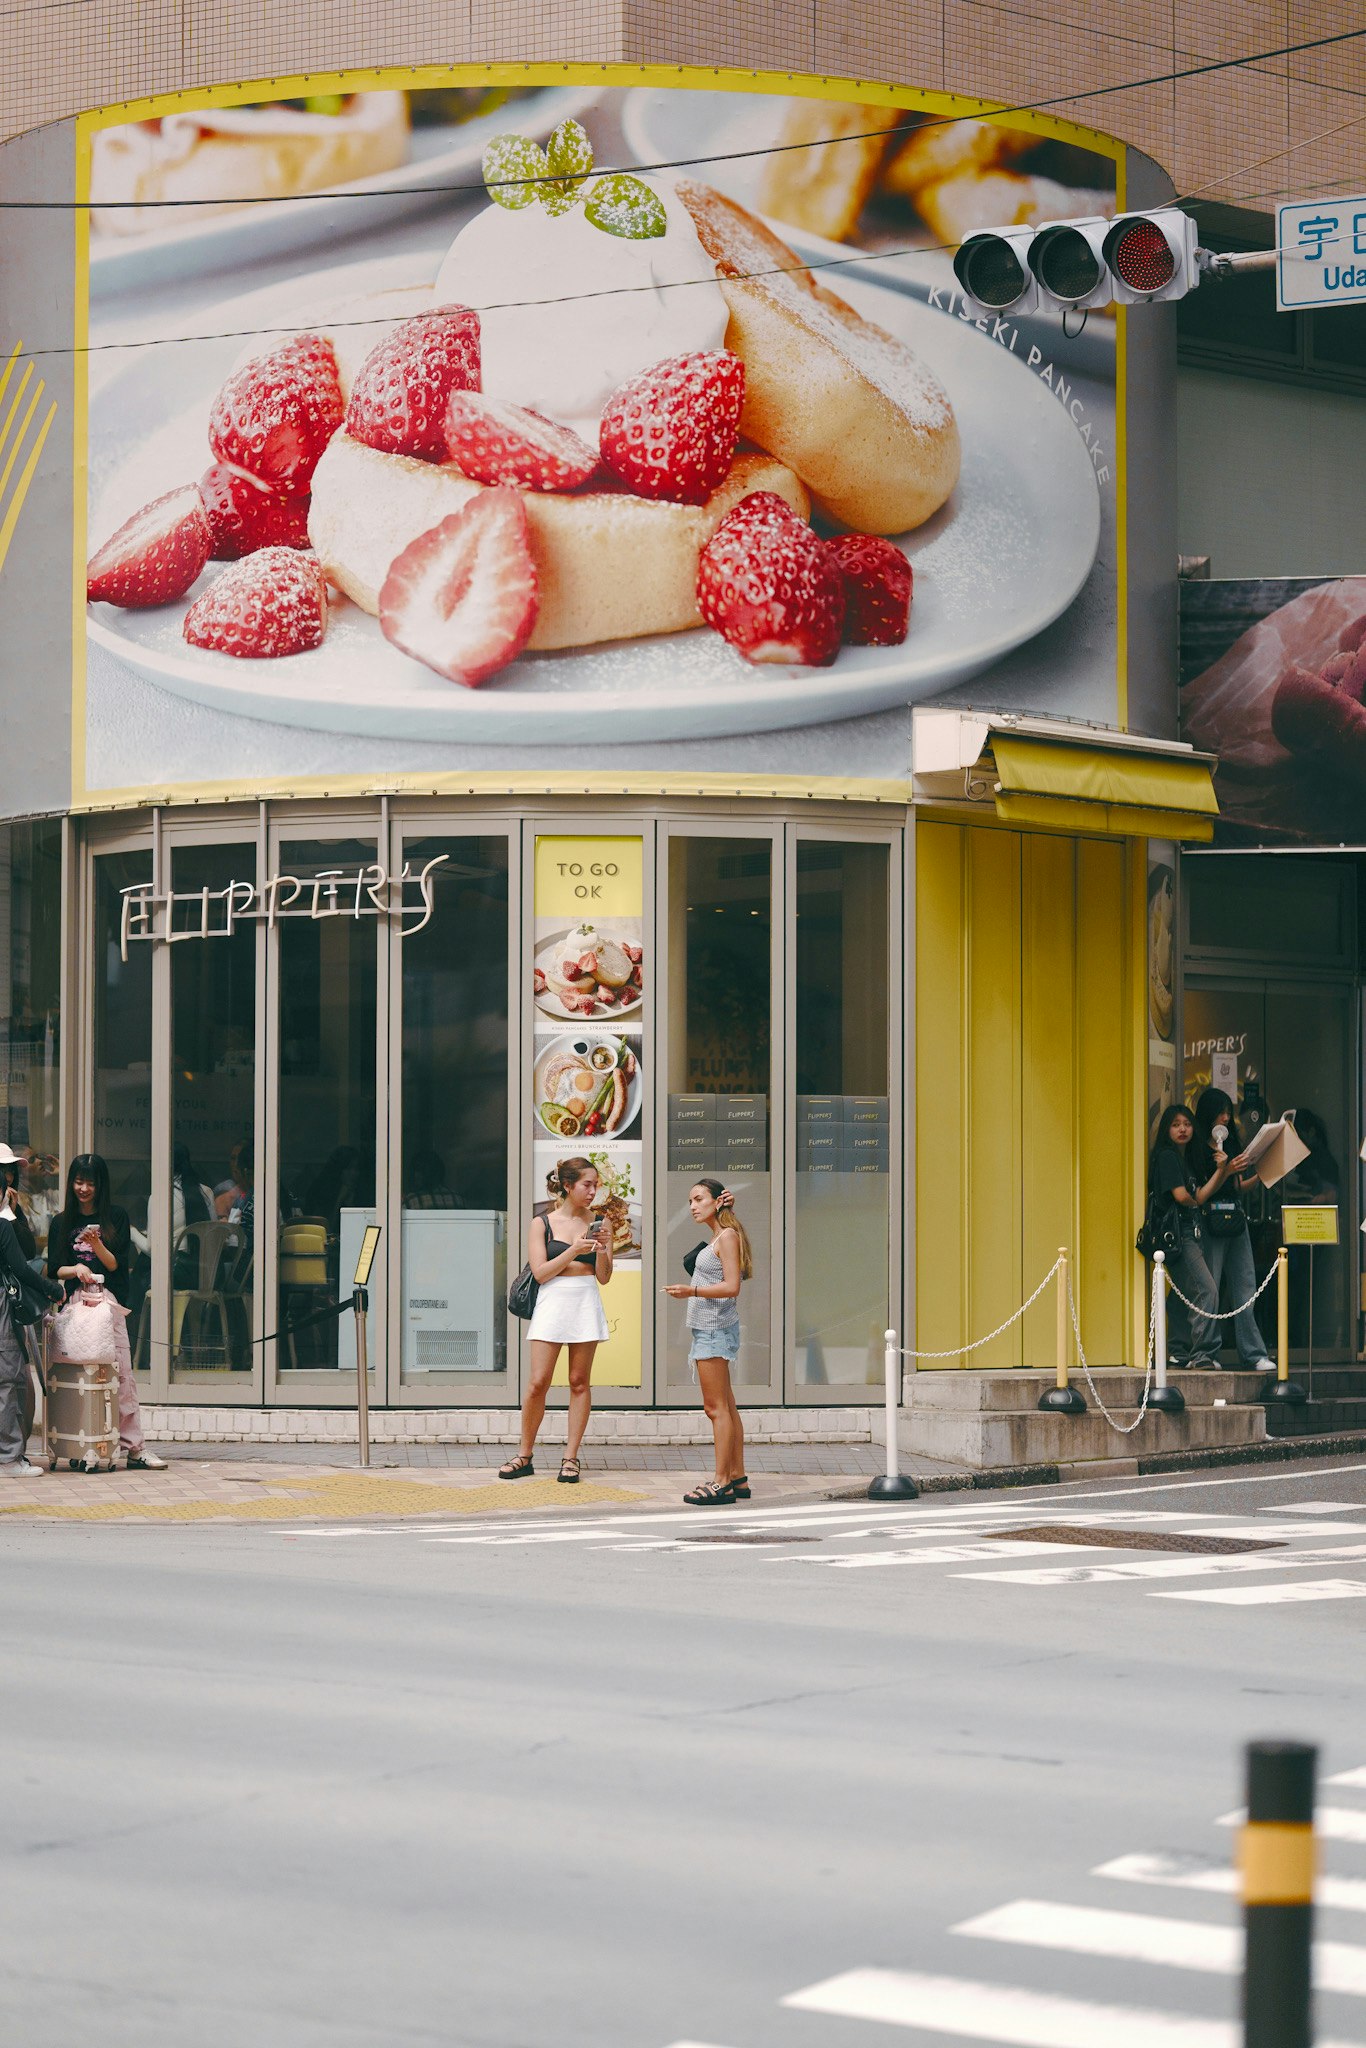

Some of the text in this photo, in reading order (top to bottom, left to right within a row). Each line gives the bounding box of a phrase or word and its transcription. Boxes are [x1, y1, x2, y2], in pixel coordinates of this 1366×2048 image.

[1026, 344, 1110, 486] PANCAKE
[556, 863, 618, 876] TO GO
[574, 885, 602, 898] OK
[119, 854, 450, 962] FLIPPER'S
